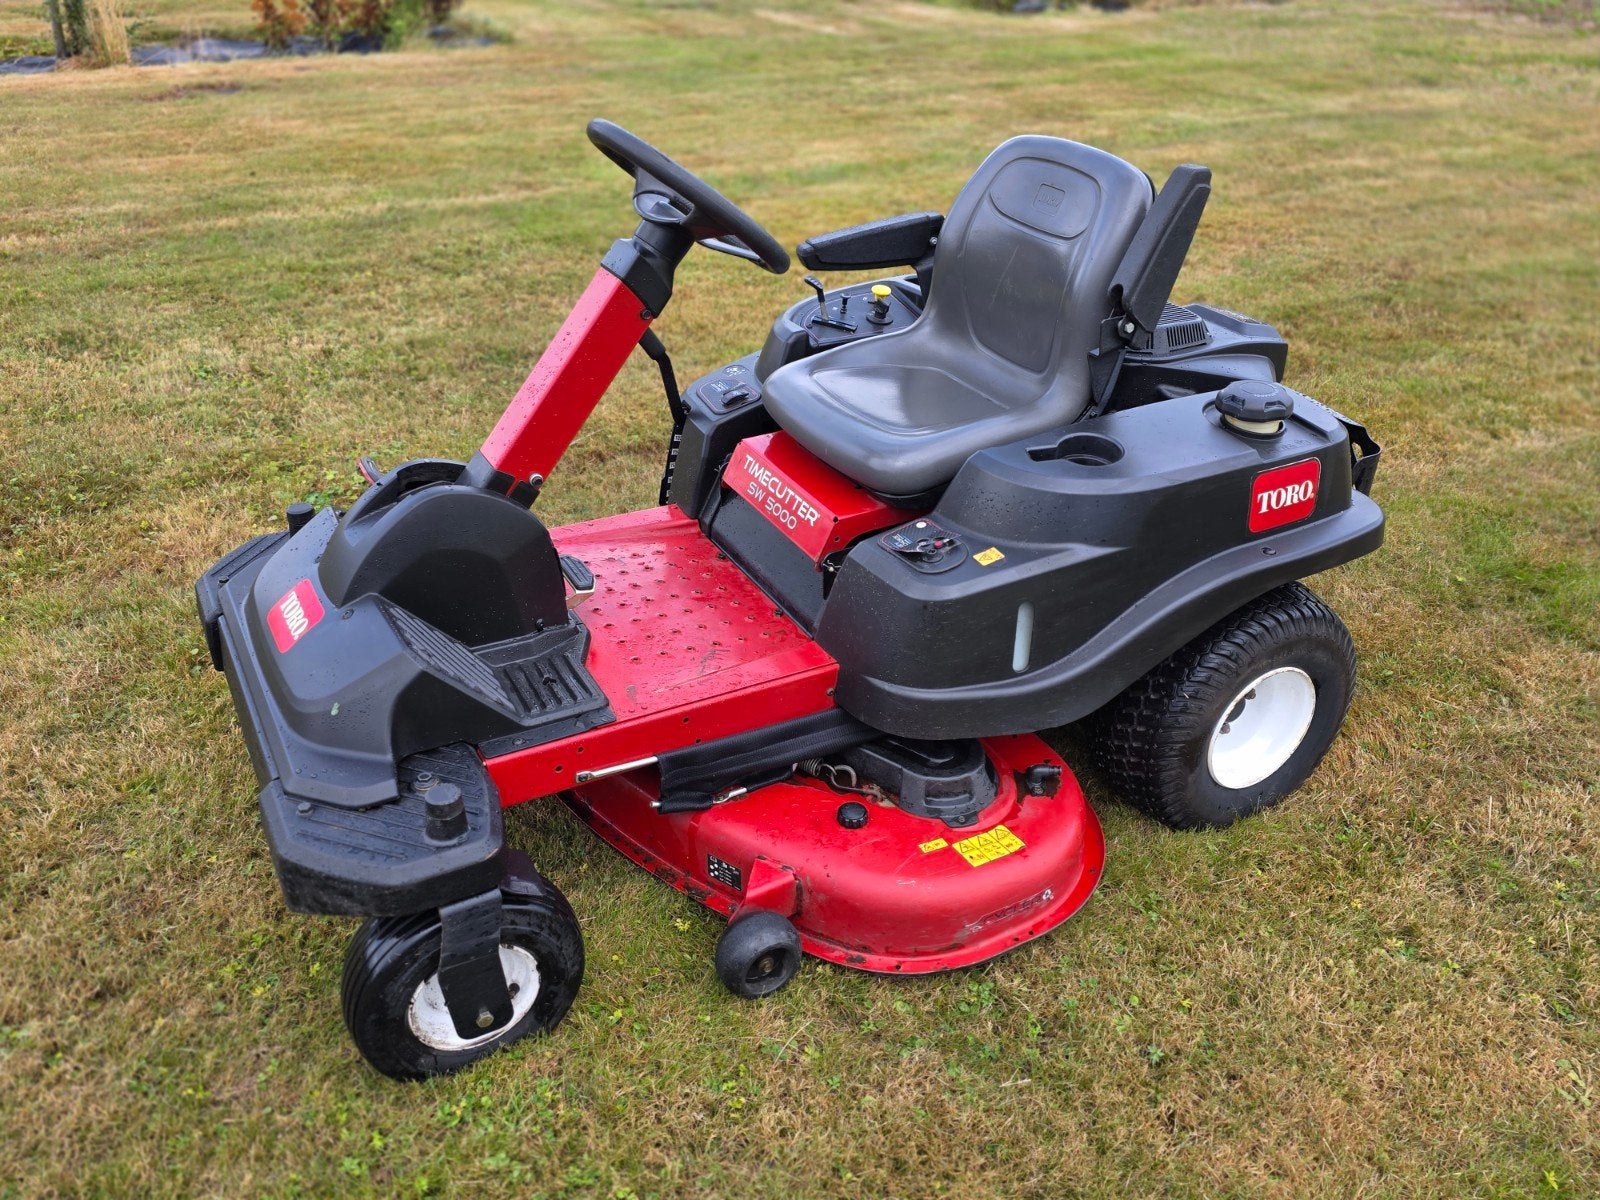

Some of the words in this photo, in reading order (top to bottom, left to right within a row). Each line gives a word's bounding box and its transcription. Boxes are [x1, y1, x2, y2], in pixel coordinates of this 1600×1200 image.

[744, 454, 818, 527] TIMECUTTER
[747, 482, 766, 503] SW
[765, 498, 797, 530] 5000
[1257, 479, 1313, 514] TORO
[280, 591, 309, 638] TORO
